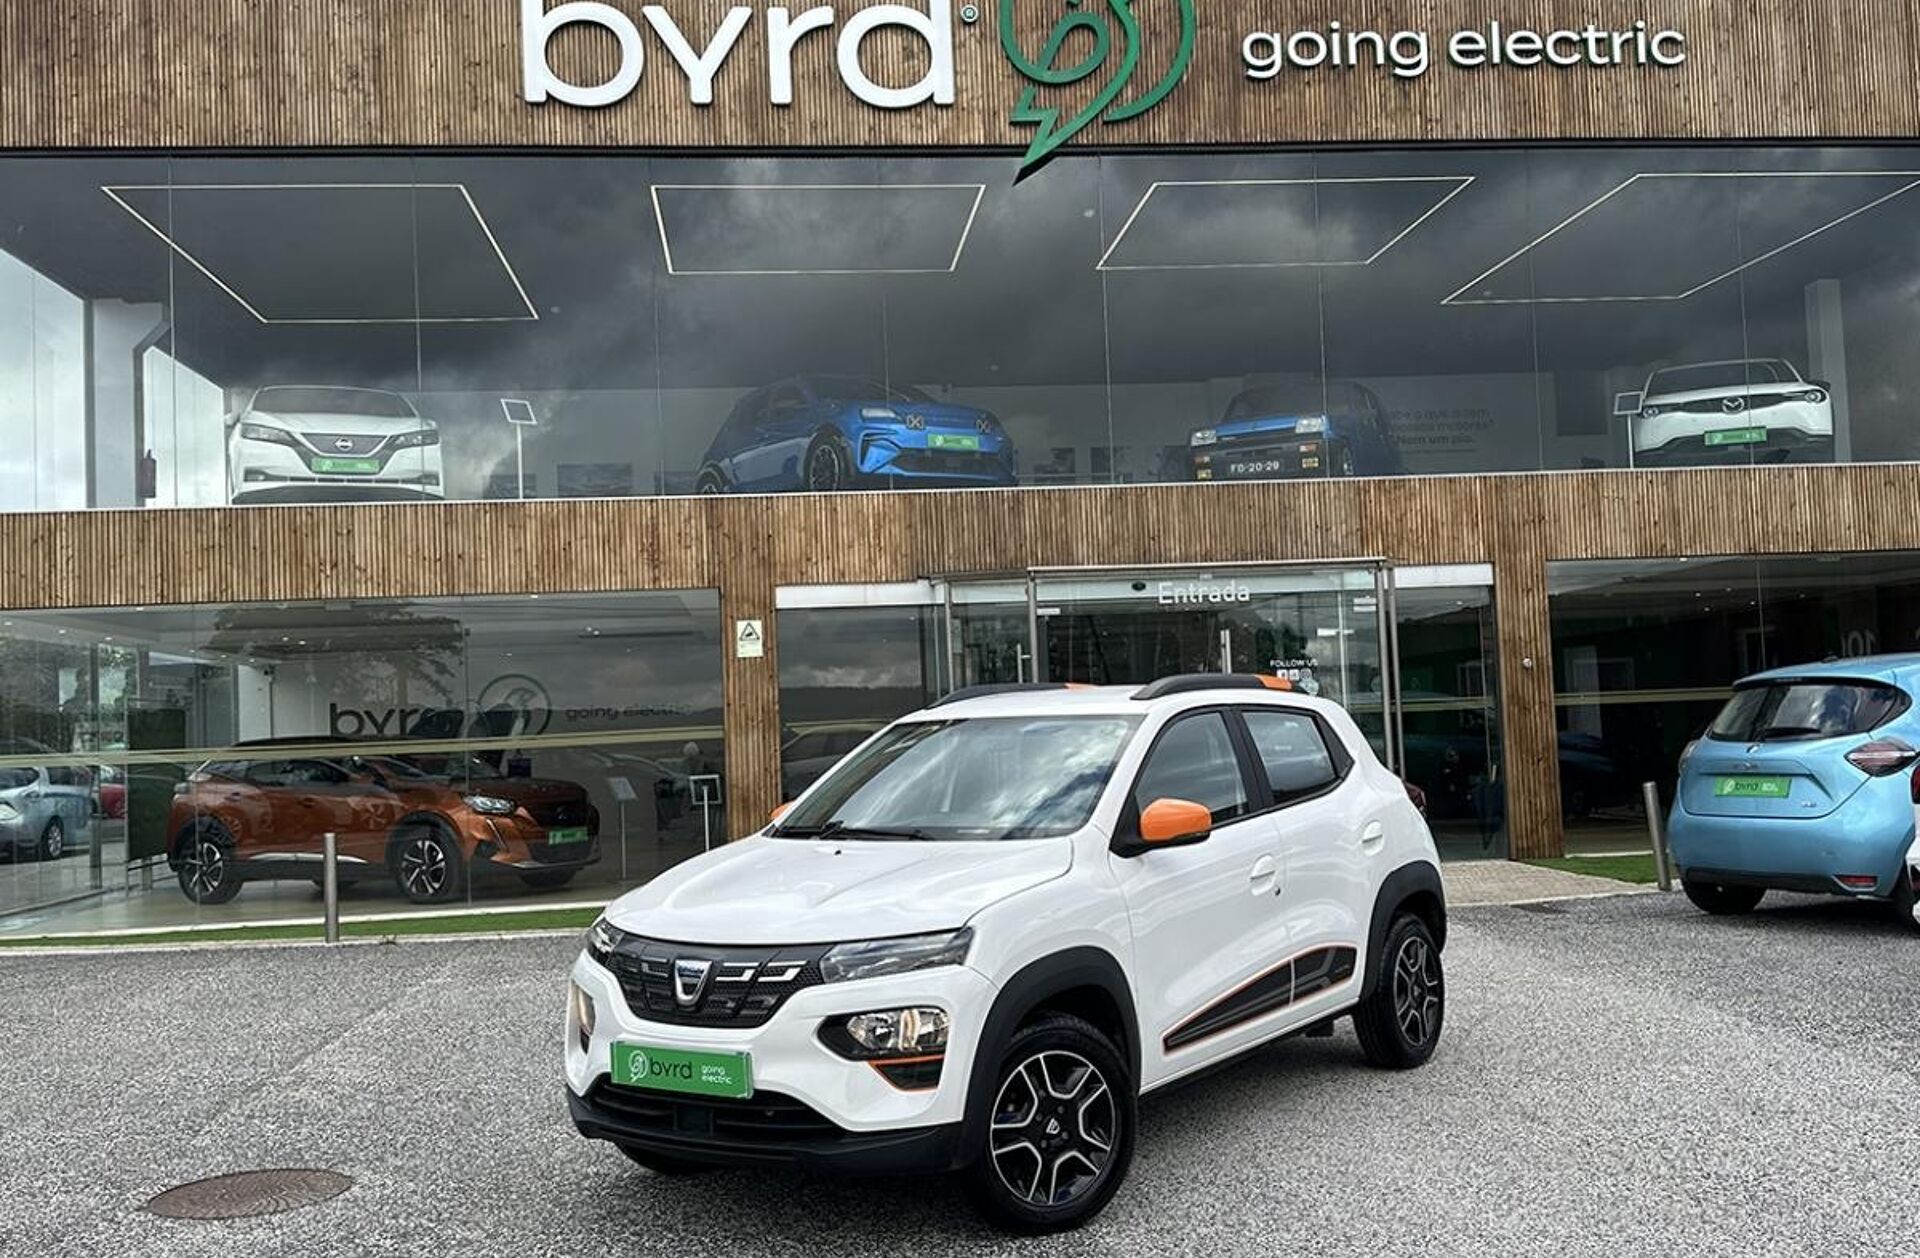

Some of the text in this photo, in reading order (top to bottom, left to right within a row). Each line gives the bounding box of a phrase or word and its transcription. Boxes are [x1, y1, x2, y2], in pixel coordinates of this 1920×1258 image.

[524, 0, 955, 108] byrd
[1242, 20, 1687, 79] going electric
[1159, 579, 1251, 604] Entrada
[1270, 658, 1319, 668] FOLLOW US
[650, 1056, 693, 1079] byrd
